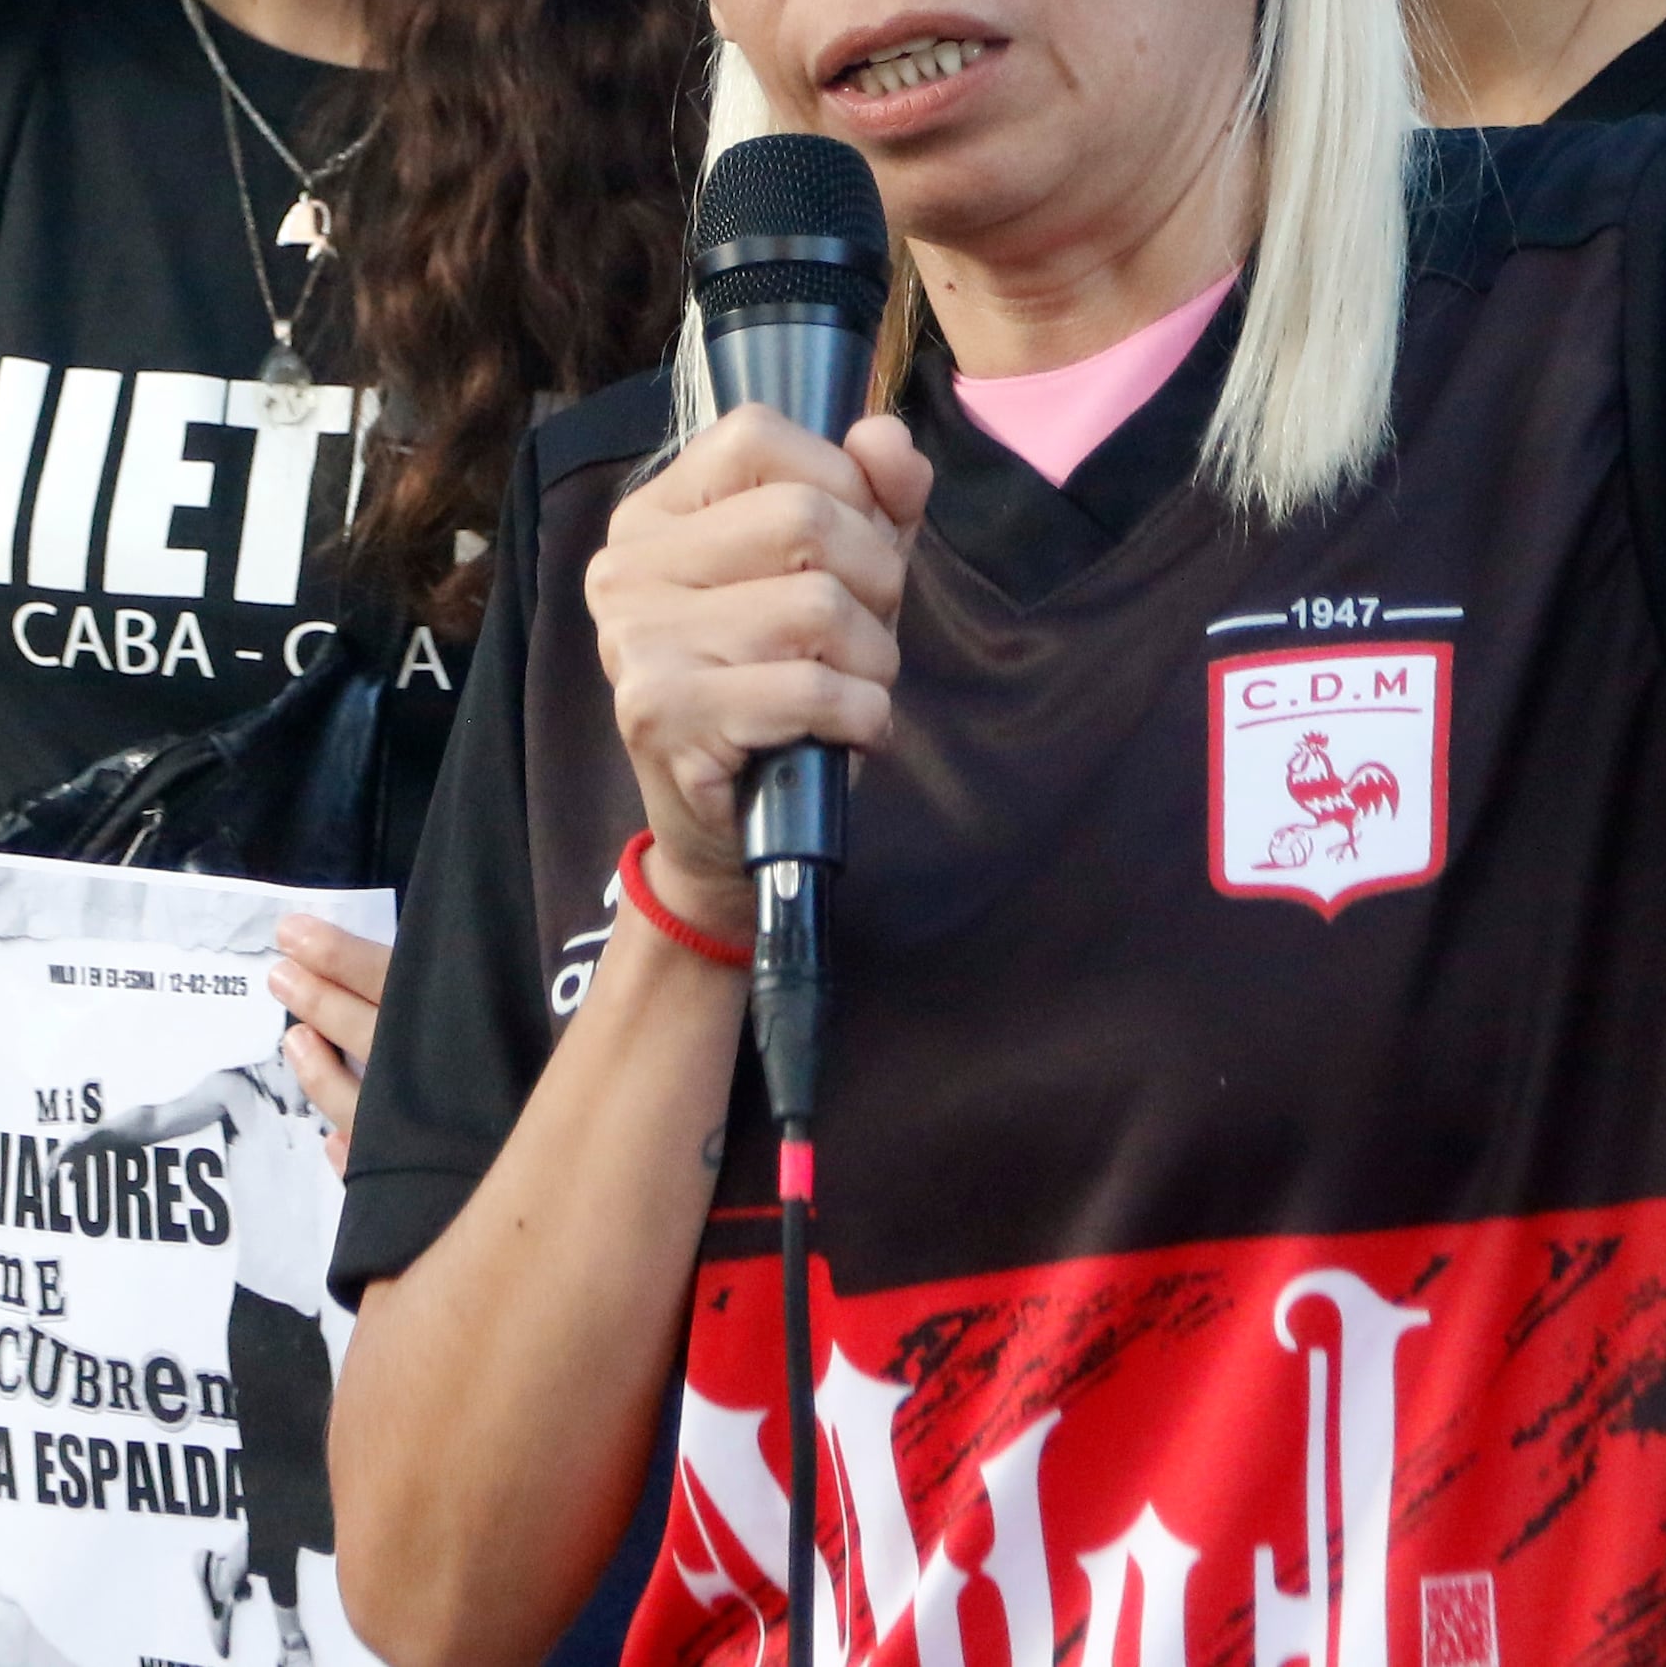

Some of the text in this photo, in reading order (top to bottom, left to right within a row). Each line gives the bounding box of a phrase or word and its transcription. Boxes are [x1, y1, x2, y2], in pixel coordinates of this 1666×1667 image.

[11, 601, 215, 679] CABA
[1290, 596, 1381, 630] 1947
[34, 1431, 247, 1520] ESPALDA
